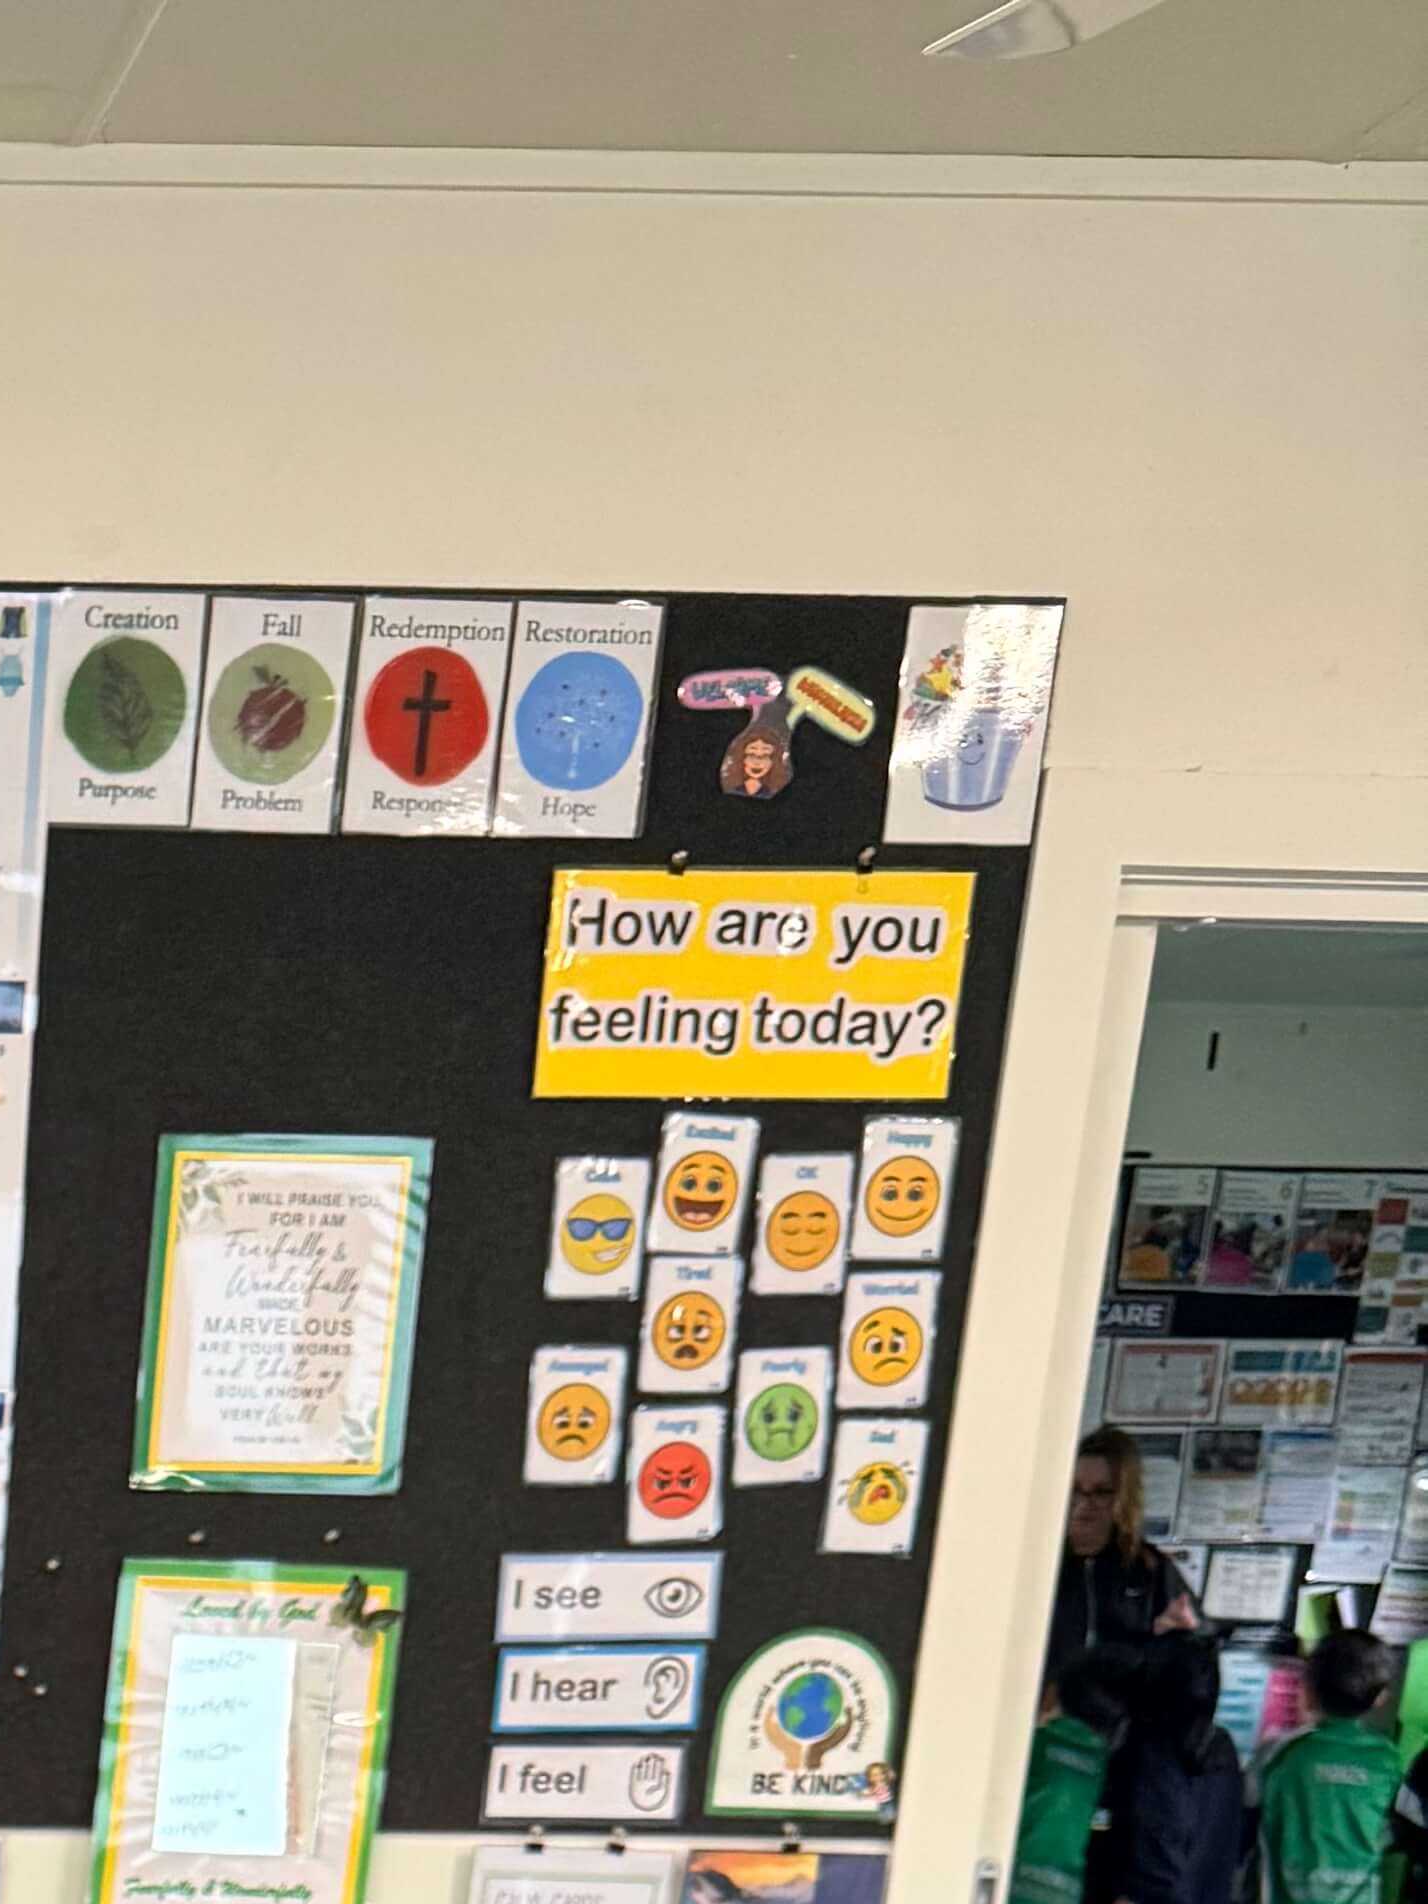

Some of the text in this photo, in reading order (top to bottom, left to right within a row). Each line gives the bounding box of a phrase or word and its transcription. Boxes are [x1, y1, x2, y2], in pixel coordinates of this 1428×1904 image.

[84, 606, 178, 631] Creation
[261, 613, 302, 637] Fall
[369, 616, 505, 647] Redemption
[525, 620, 653, 645] Restoration
[78, 778, 156, 804] Purpose
[221, 790, 303, 813] Problem
[542, 797, 597, 819] Hope
[567, 897, 941, 963] How are you
[548, 993, 945, 1057] feeling today?
[204, 1316, 355, 1336] MARVELOUS
[512, 1580, 600, 1609] I see
[510, 1671, 618, 1702] I hear
[498, 1762, 586, 1793] I feel
[751, 1773, 782, 1794] BE
